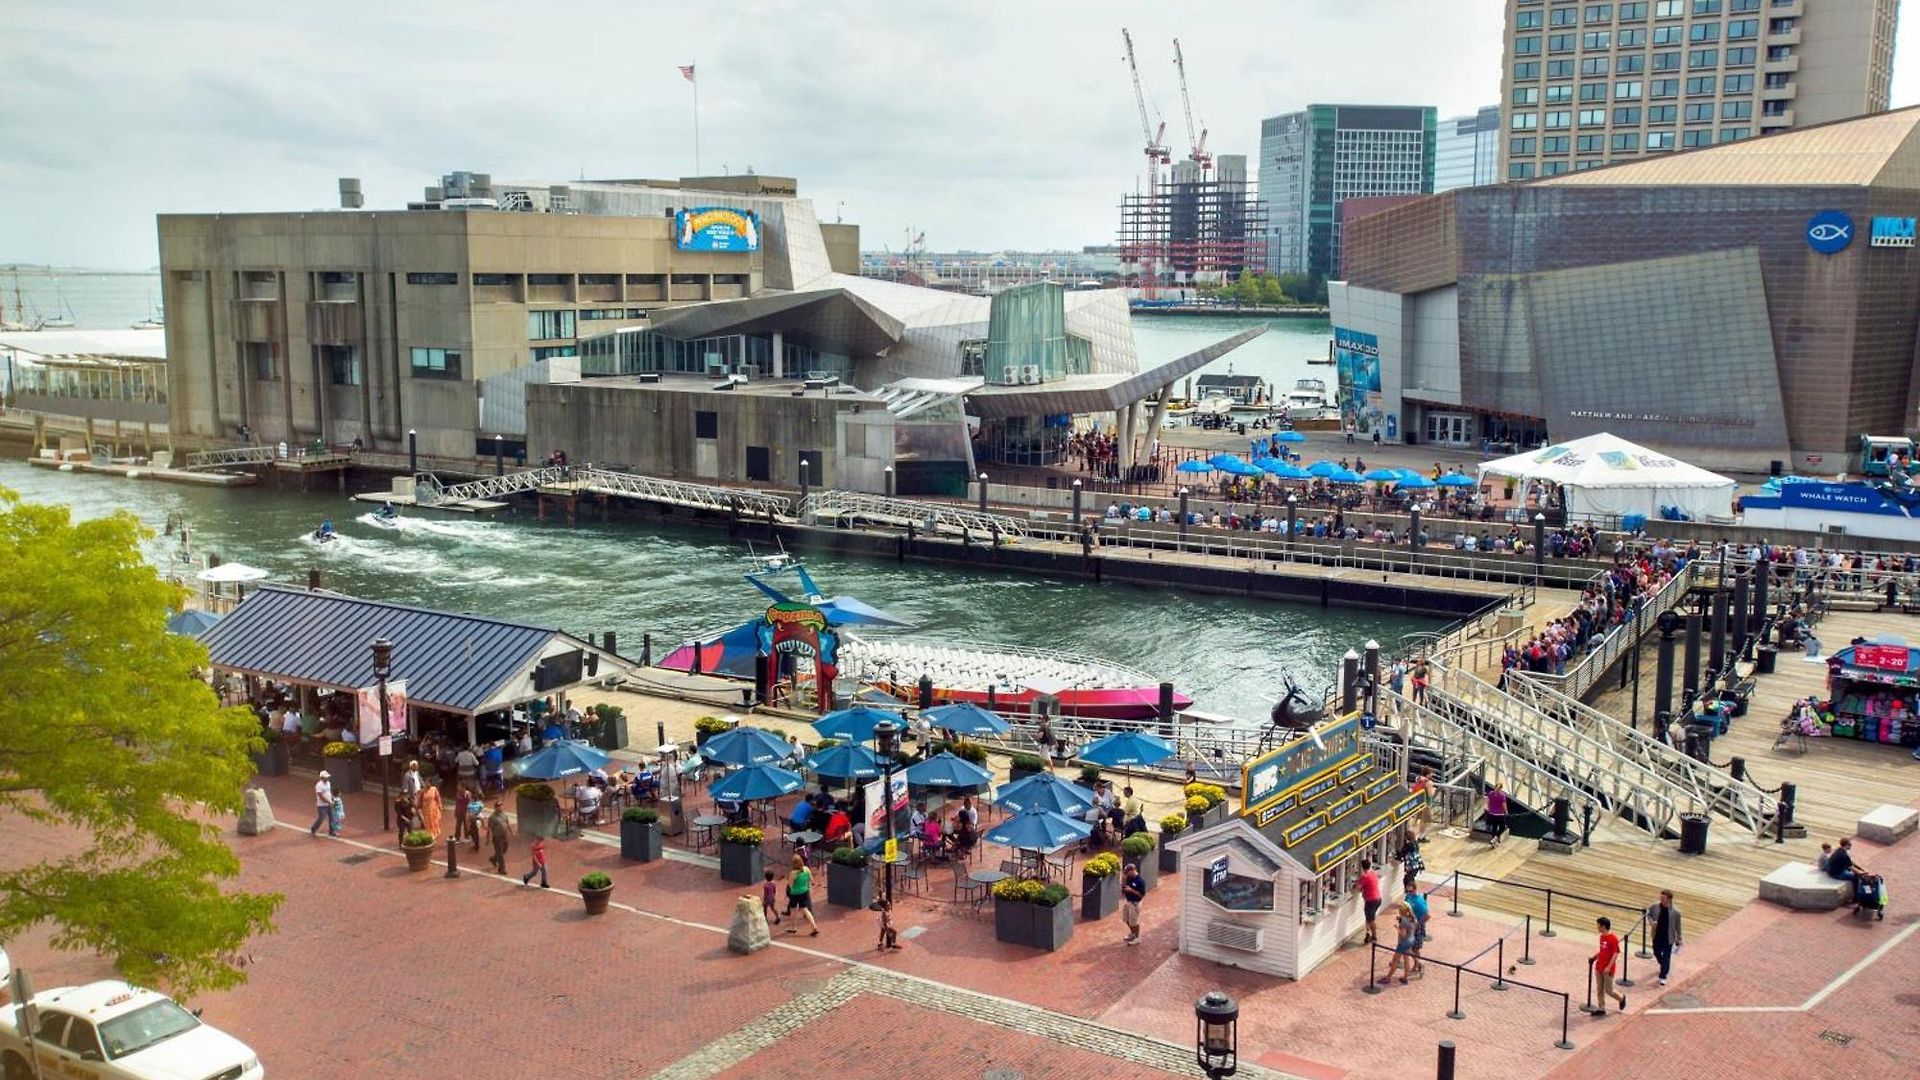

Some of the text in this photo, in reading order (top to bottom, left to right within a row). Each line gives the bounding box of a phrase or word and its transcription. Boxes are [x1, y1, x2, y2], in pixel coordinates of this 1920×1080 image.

[1872, 216, 1916, 237] IMAX
[1871, 237, 1915, 246] THEATRE
[1339, 340, 1363, 351] IMAX
[1800, 492, 1867, 503] WHALE WATCH
